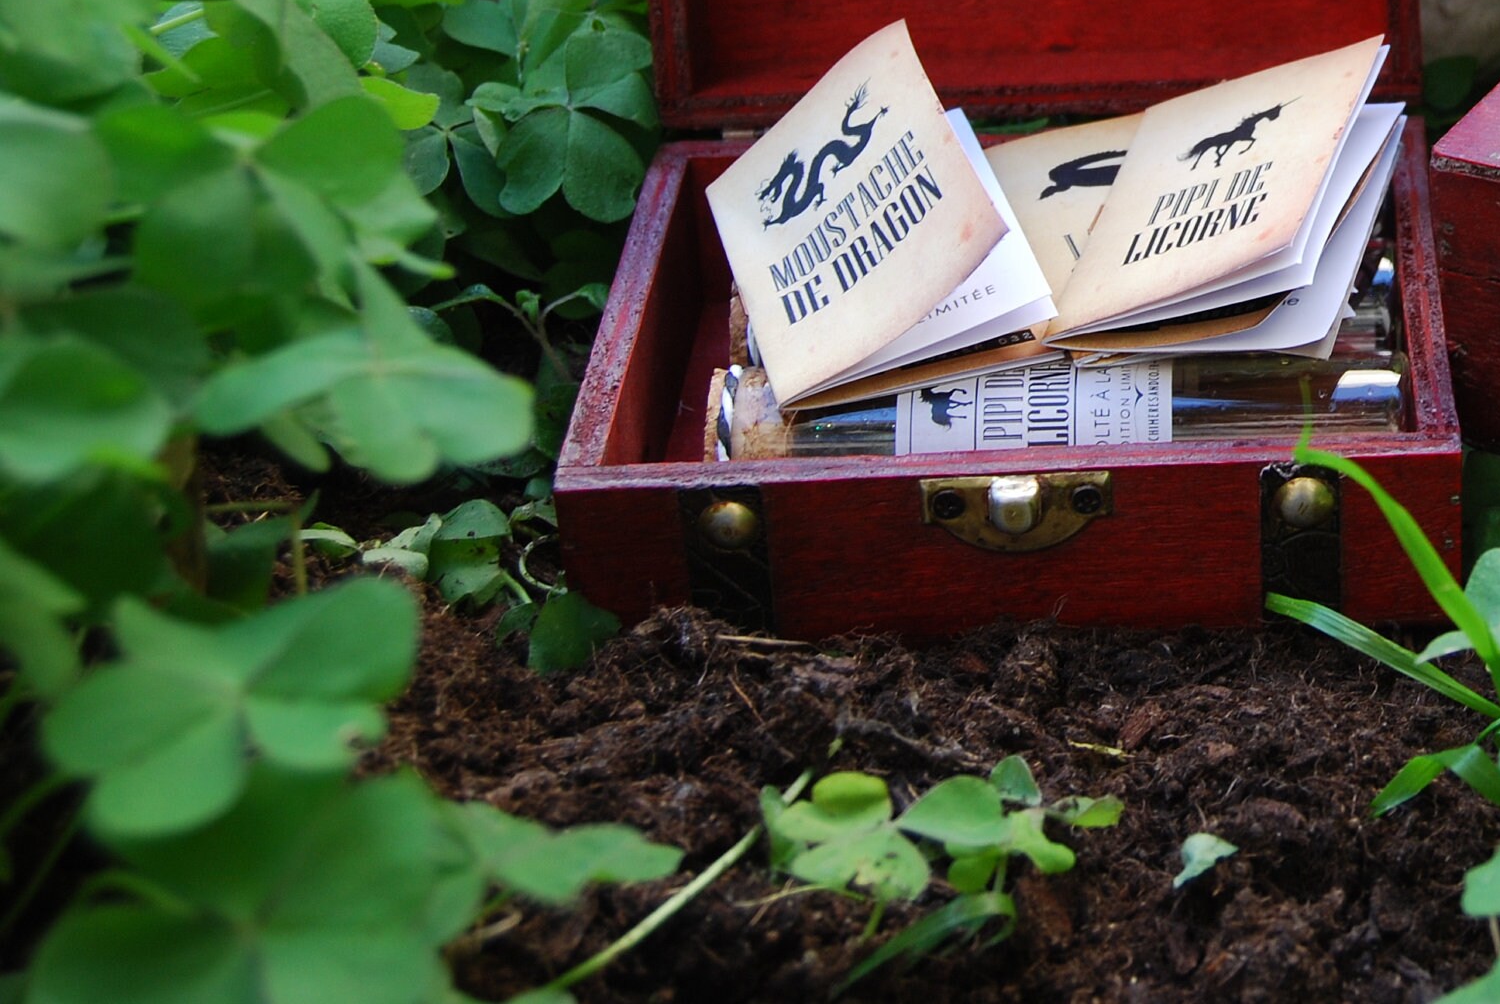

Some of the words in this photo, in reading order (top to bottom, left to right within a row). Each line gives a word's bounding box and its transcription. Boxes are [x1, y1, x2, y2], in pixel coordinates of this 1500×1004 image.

[769, 130, 924, 292] MOUSTACHE
[1121, 192, 1268, 267] LICORNE
[1147, 178, 1222, 226] PIPI
[1223, 161, 1273, 204] DE
[781, 274, 830, 326] DE
[832, 163, 943, 295] DRAGON
[983, 395, 1023, 440] PIPI
[1027, 363, 1071, 447] LICORNE
